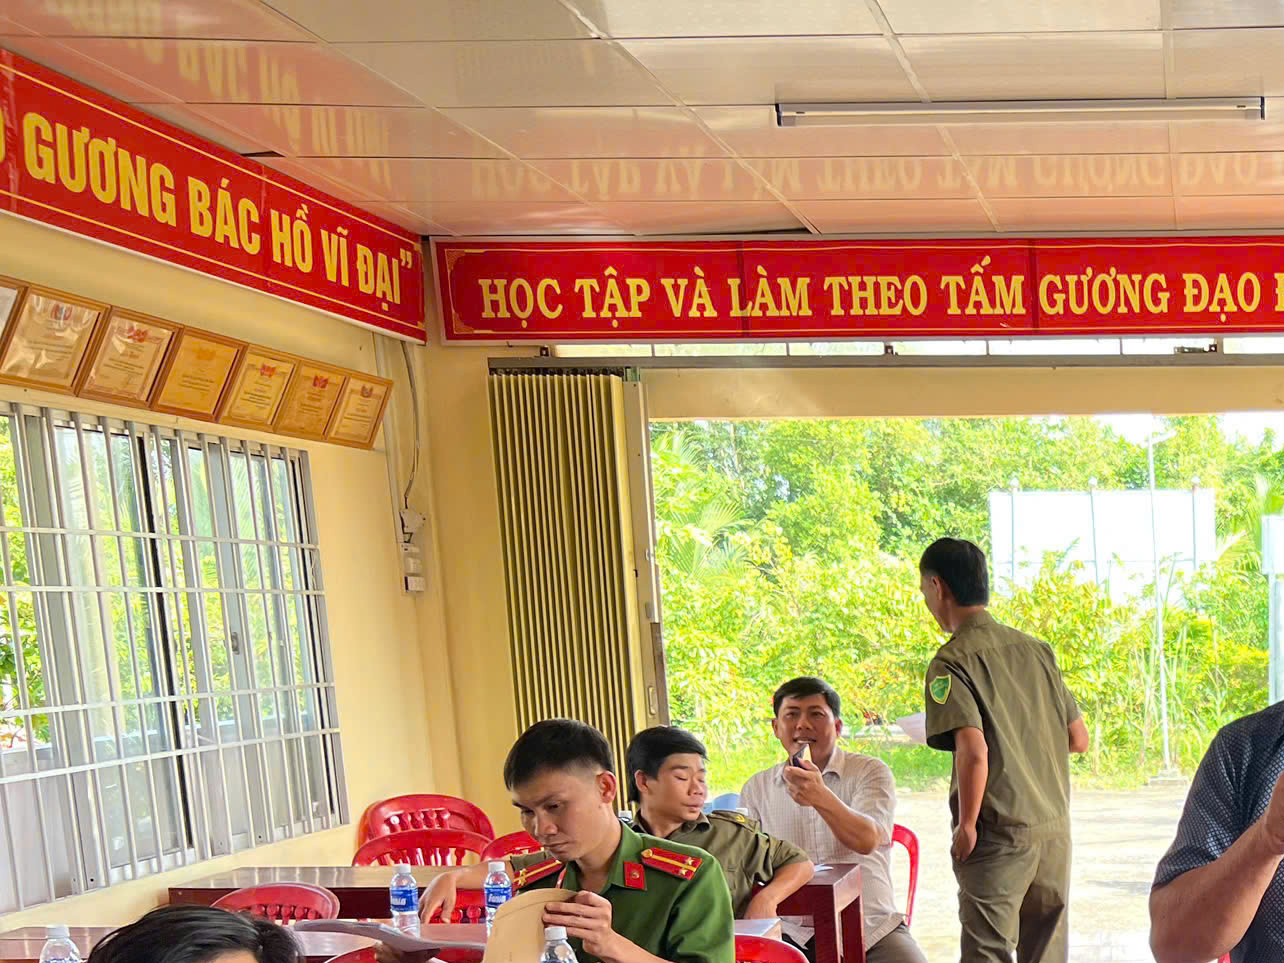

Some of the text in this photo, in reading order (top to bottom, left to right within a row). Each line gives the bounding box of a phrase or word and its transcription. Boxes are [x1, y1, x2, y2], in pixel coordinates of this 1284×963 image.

[23, 112, 177, 227] GƯƠNG
[187, 177, 261, 255] BÁC
[270, 203, 313, 273] HỒ
[320, 226, 349, 287] VĨ
[478, 278, 563, 328] HỌC
[574, 265, 650, 328] TẬP
[660, 266, 718, 318] VÀ
[728, 265, 812, 317] LÀM
[824, 275, 928, 316] THEO
[940, 255, 1026, 315] TẤM
[1039, 266, 1170, 315] GƯƠNG
[1183, 272, 1261, 323] ĐẠO
